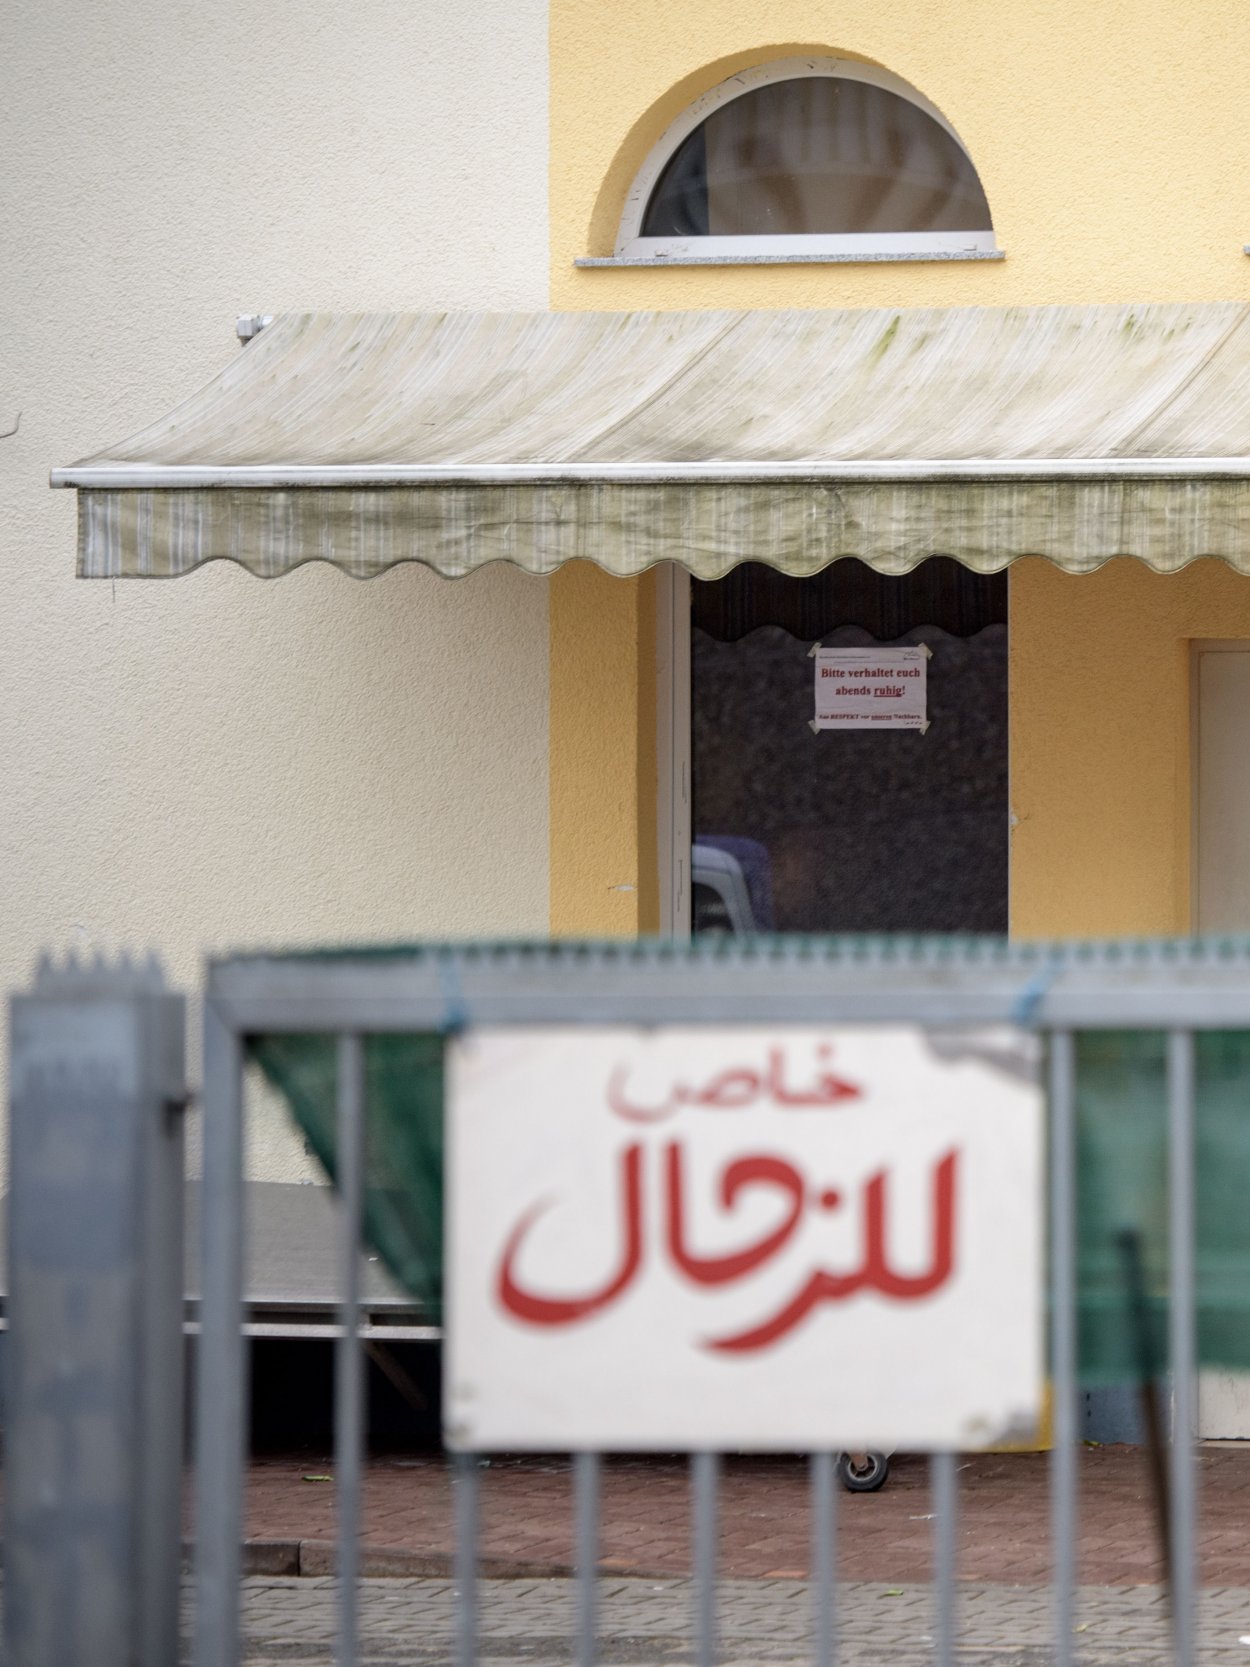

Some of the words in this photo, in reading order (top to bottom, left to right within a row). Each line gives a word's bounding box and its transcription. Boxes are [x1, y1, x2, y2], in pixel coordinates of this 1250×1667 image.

[821, 667, 846, 677] Bitte
[848, 667, 894, 677] verhaltet
[897, 667, 920, 677] euch
[835, 686, 871, 695] abends
[874, 685, 906, 697] ruhig!
[605, 1041, 866, 1124] خاص
